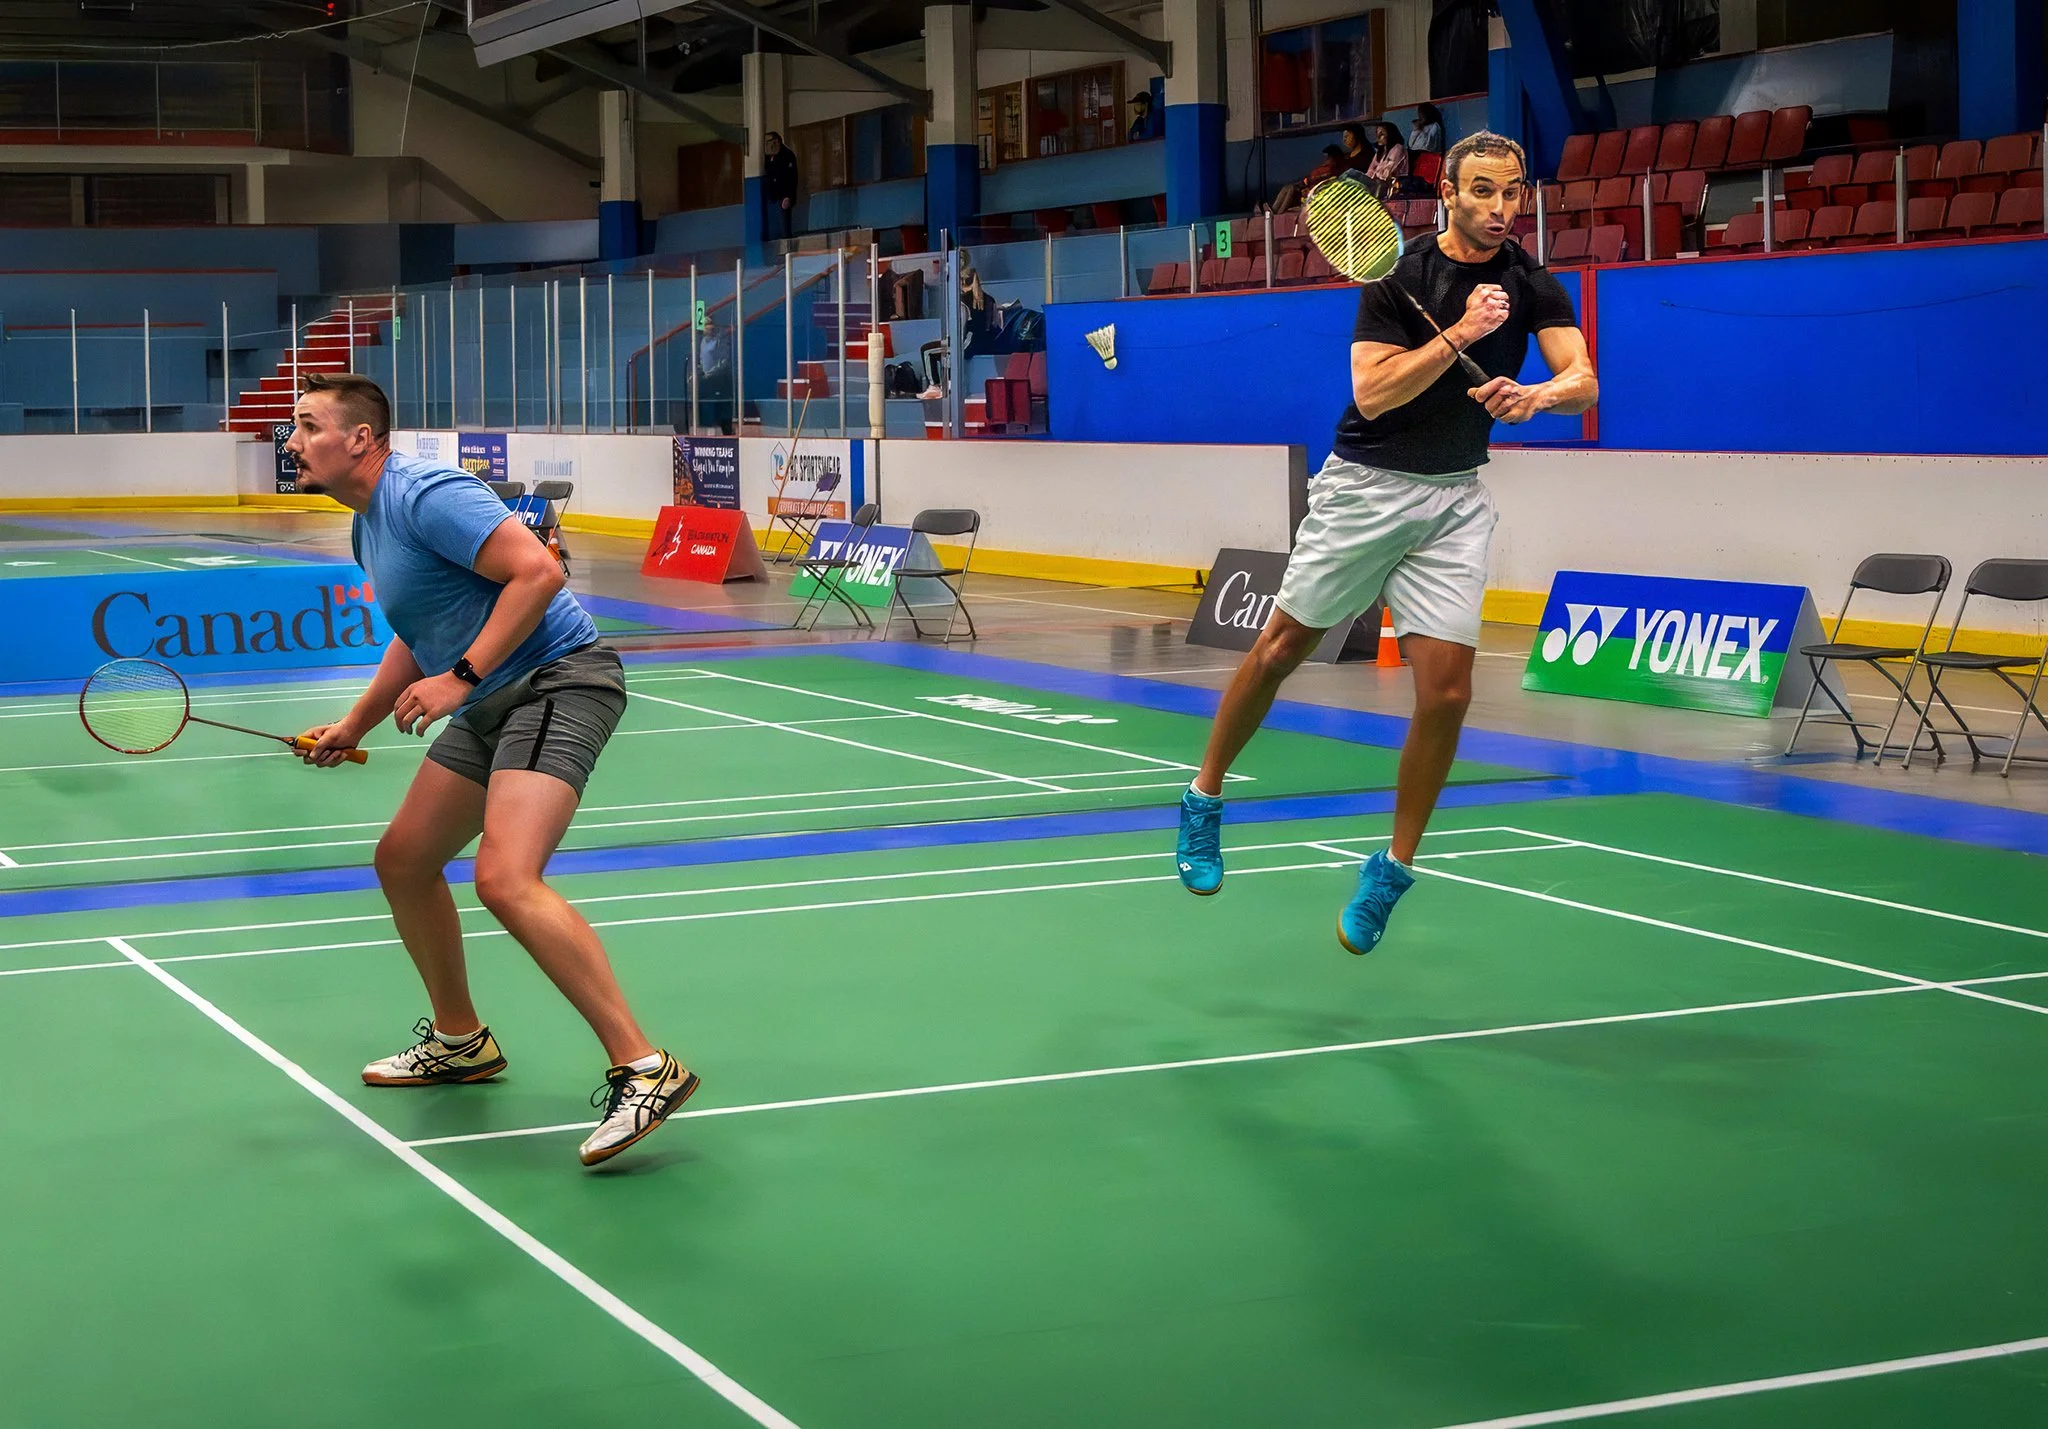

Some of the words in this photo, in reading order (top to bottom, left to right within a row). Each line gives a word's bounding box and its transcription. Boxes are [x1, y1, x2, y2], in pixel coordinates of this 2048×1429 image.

[1219, 229, 1228, 252] 3
[697, 307, 704, 325] 2
[844, 541, 906, 587] YONEX
[91, 585, 385, 660] Canada
[1214, 570, 1278, 631] Can
[1628, 607, 1779, 684] YONEX
